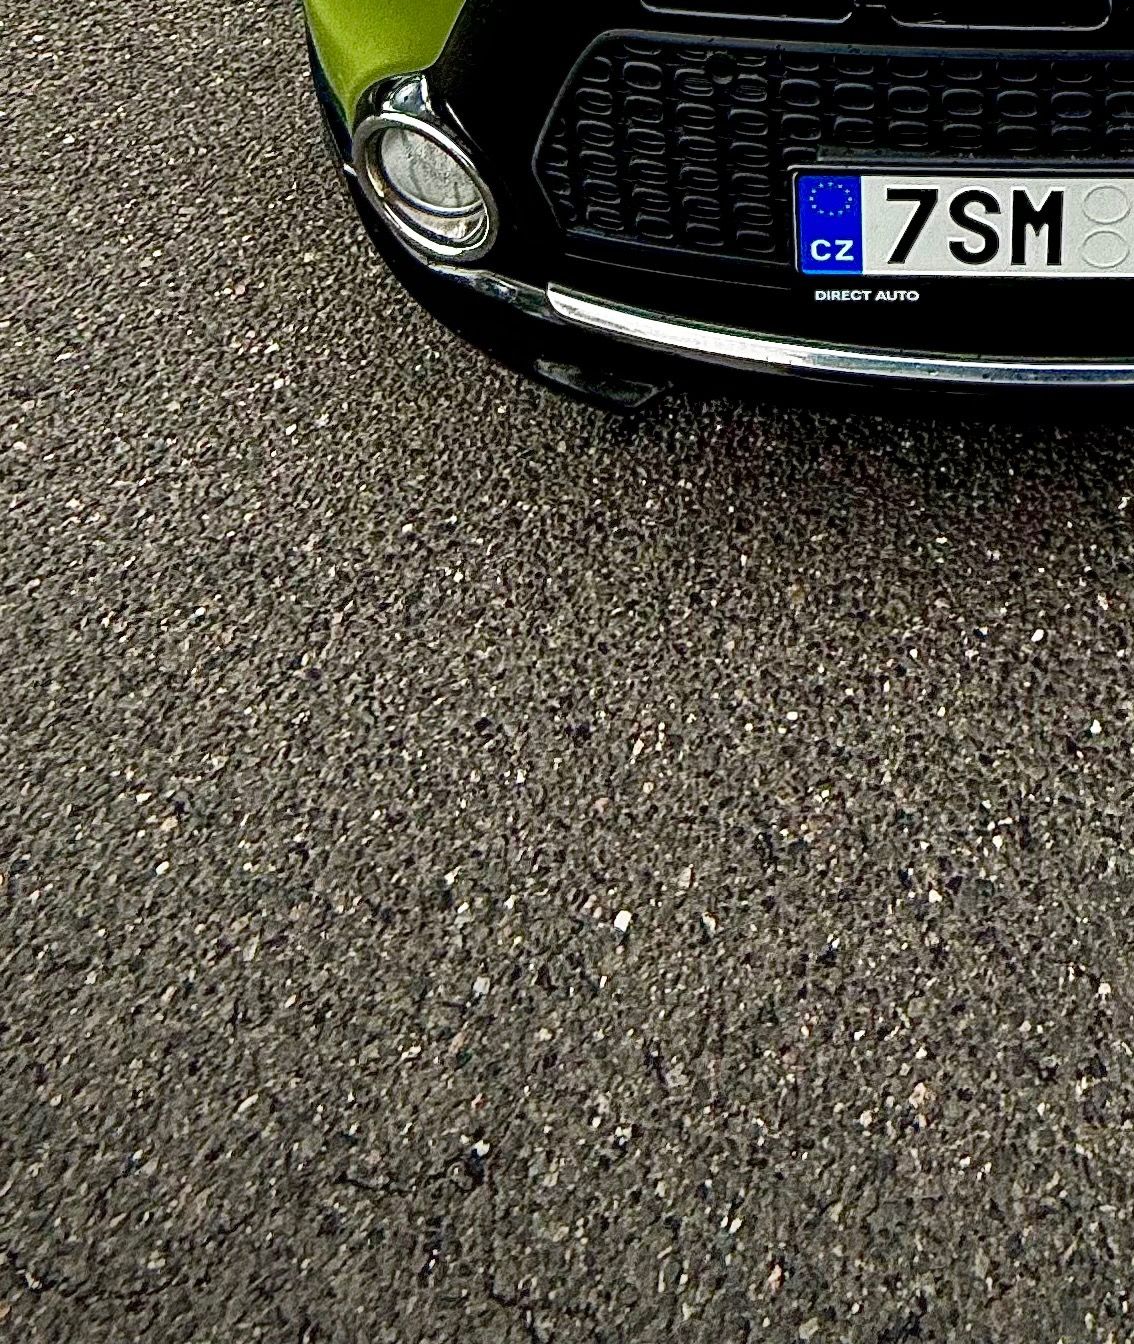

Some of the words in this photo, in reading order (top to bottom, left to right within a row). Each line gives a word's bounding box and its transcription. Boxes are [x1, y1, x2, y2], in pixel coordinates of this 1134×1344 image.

[886, 187, 1065, 266] 7SM
[809, 238, 855, 262] CZ
[814, 289, 873, 301] DIRECT
[874, 289, 920, 302] AUTO
